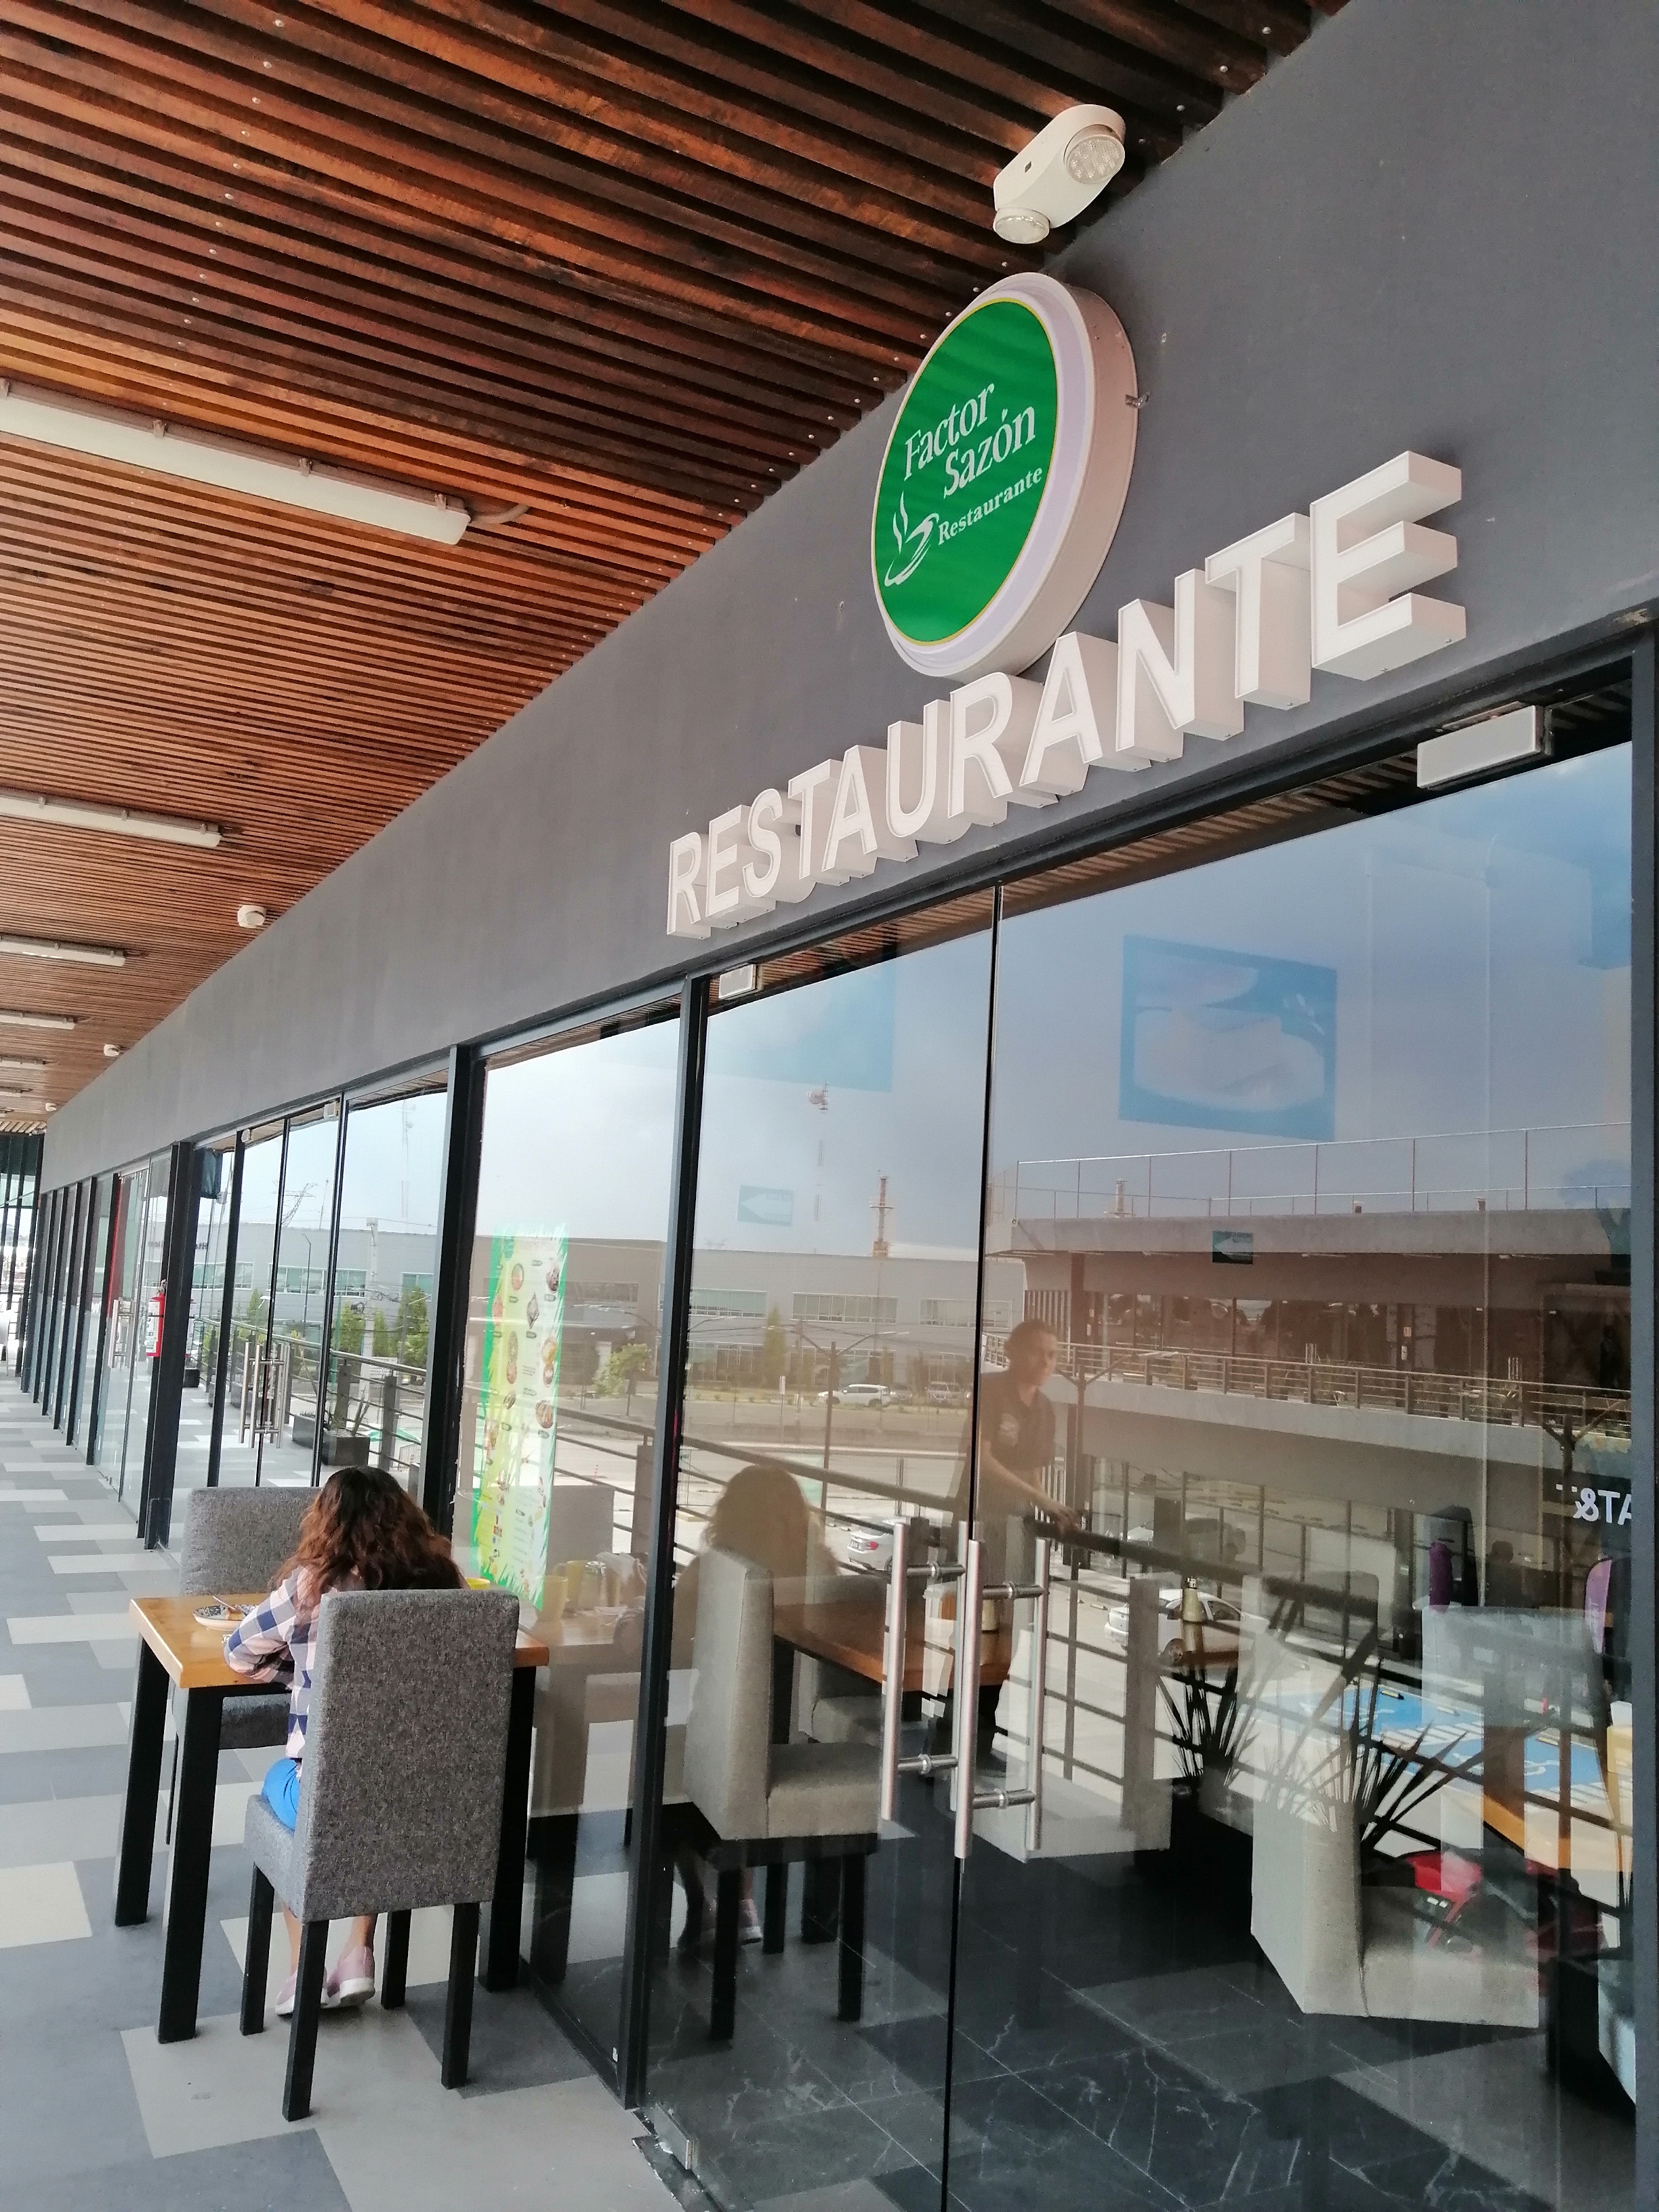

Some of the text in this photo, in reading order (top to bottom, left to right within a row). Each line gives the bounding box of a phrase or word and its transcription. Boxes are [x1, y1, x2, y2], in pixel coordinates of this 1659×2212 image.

[904, 383, 995, 481] Factor
[943, 406, 1036, 499] Sazón
[938, 468, 1042, 545] Restaurante
[666, 451, 1416, 937] RESTAURANTE
